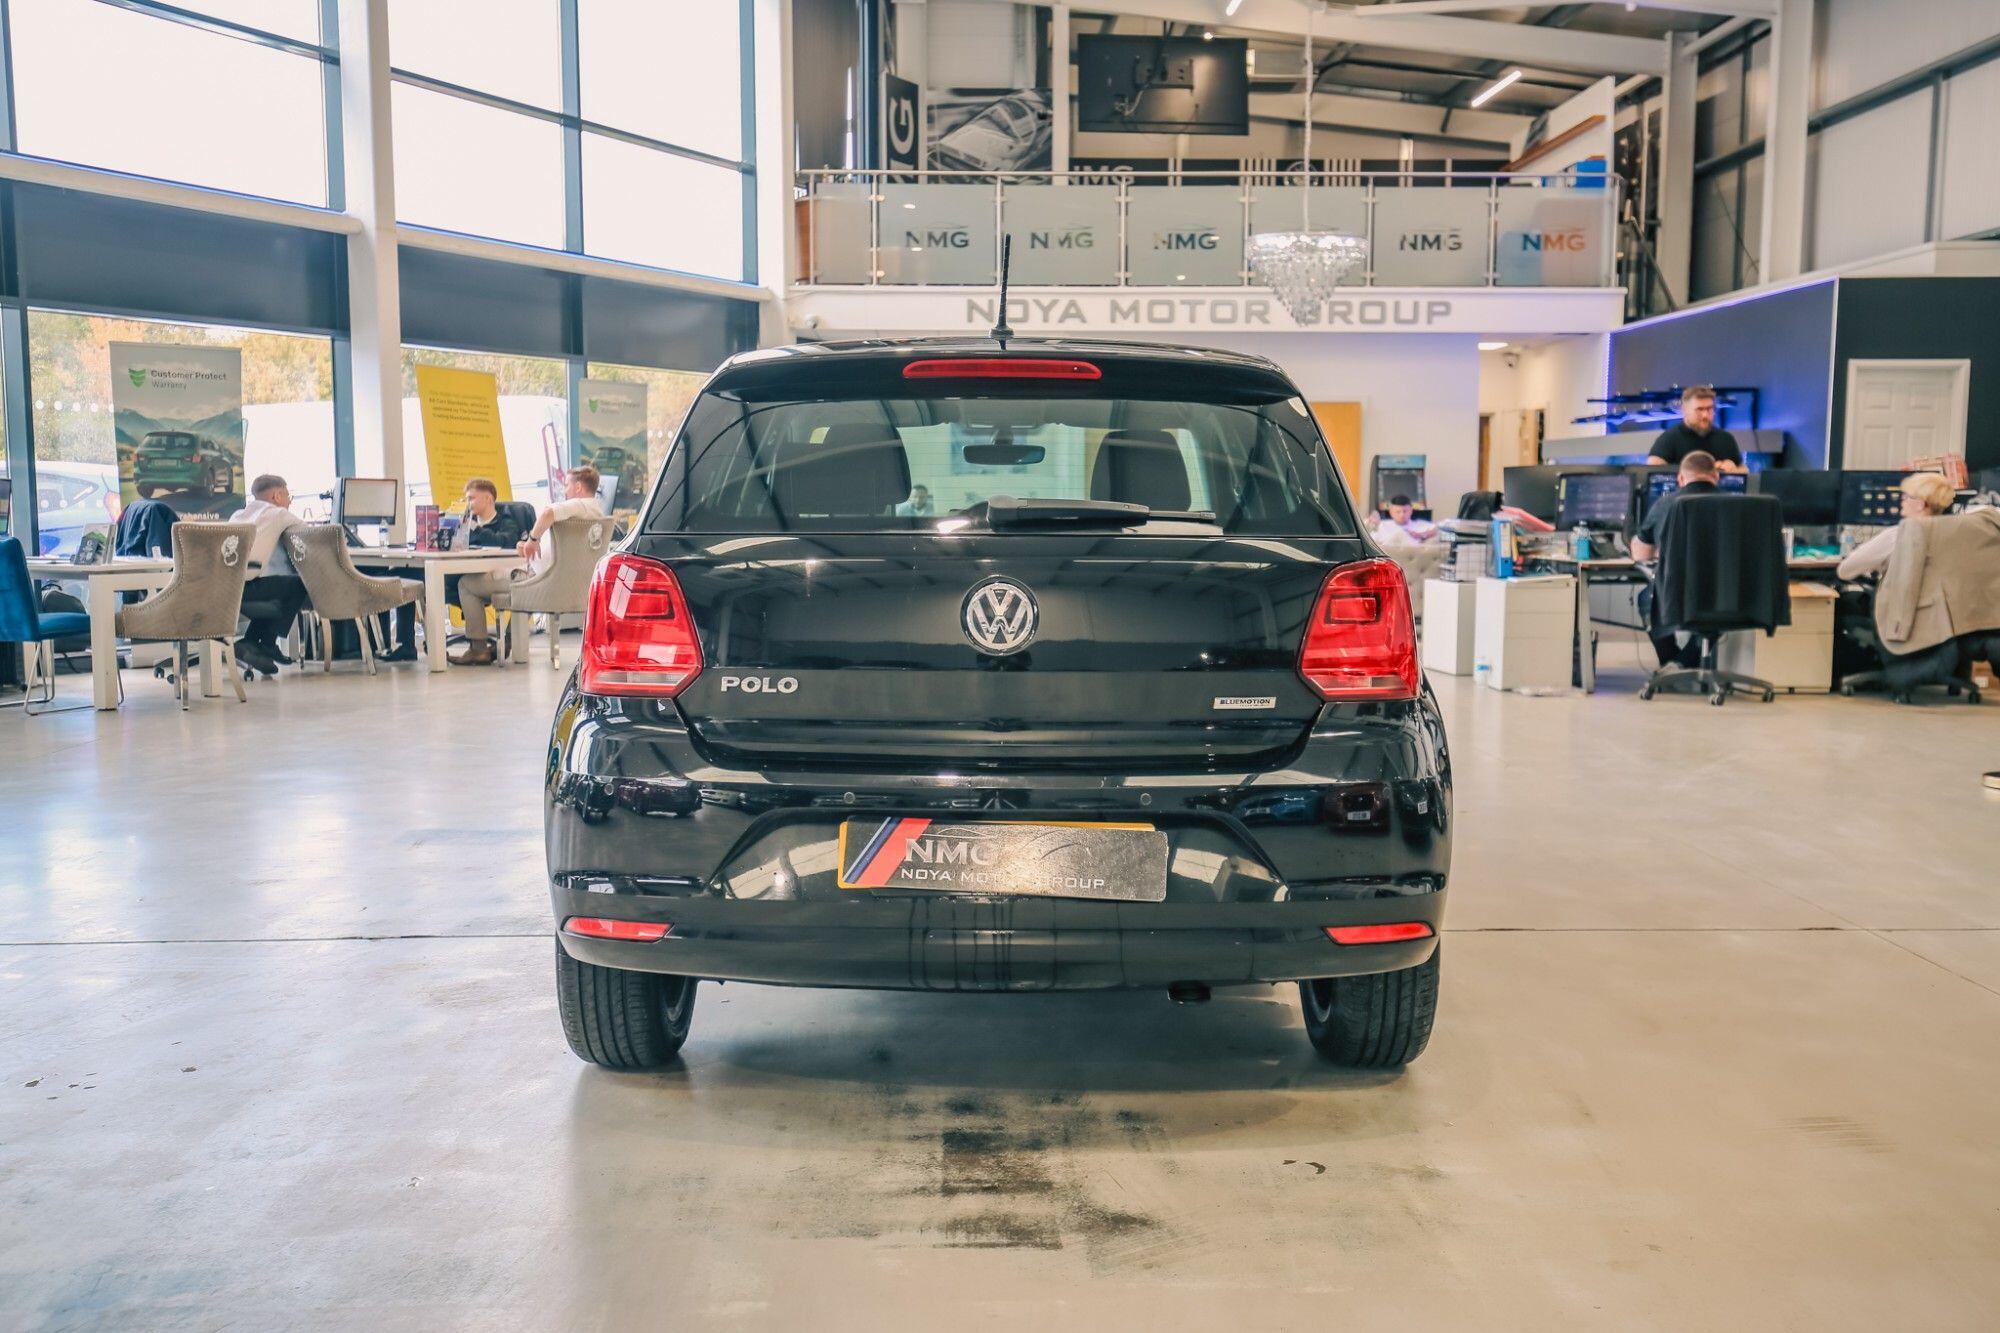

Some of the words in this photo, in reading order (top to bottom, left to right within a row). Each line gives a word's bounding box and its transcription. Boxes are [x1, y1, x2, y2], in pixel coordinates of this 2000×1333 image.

[906, 231, 970, 248] NMG
[1522, 233, 1586, 250] NMG
[966, 298, 1087, 324] NOYA
[1110, 299, 1270, 324] MOTOR
[150, 369, 194, 380] Customer
[195, 372, 227, 381] Protect
[720, 676, 799, 694] POLO
[901, 868, 952, 881] NOYA
